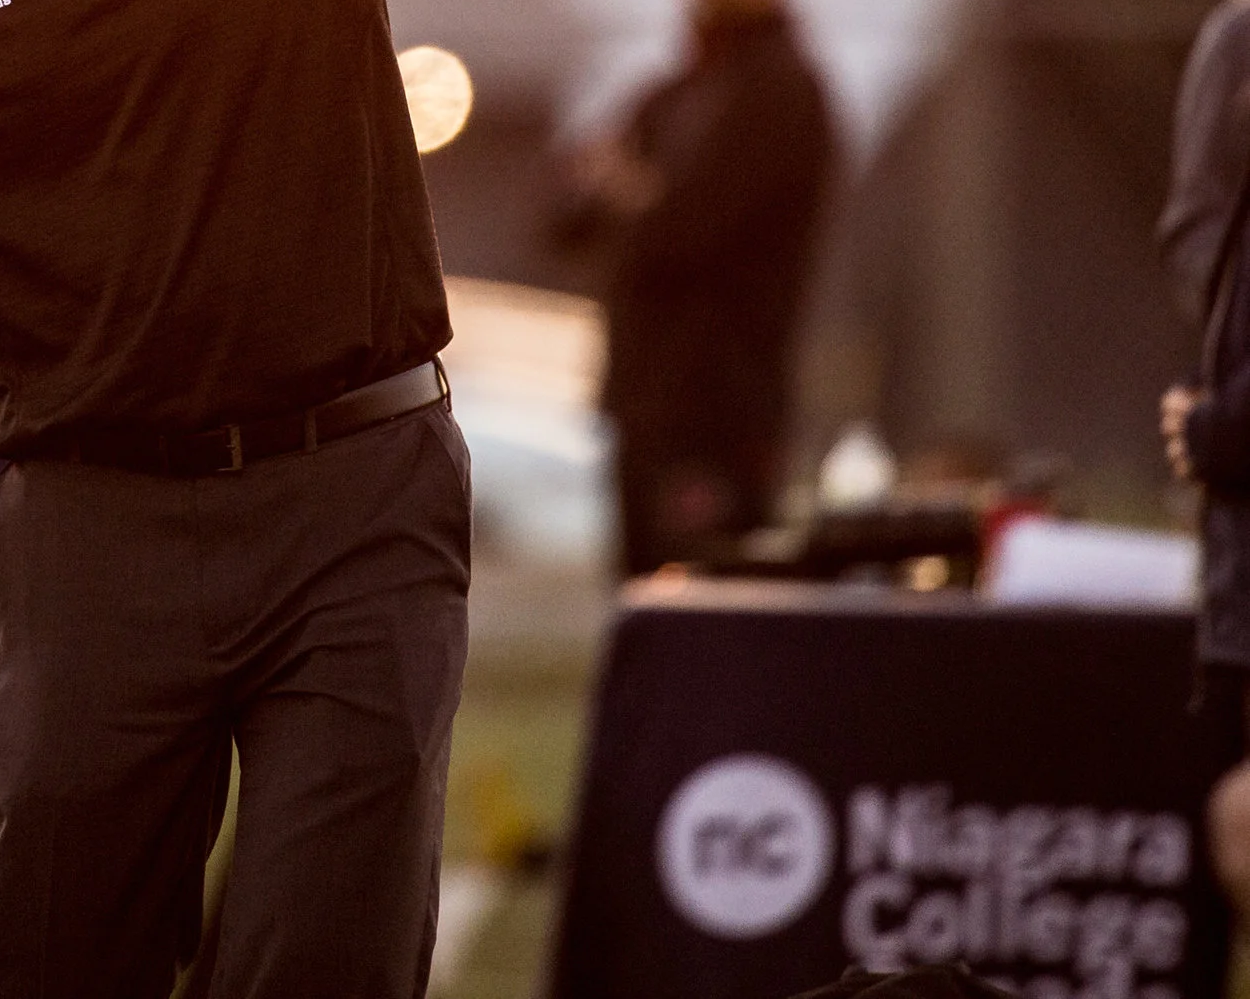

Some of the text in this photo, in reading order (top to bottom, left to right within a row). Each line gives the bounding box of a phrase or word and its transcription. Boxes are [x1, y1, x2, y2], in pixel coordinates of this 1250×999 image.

[686, 809, 798, 880] nc
[848, 783, 1194, 908] Niagara
[843, 872, 1191, 990] College
